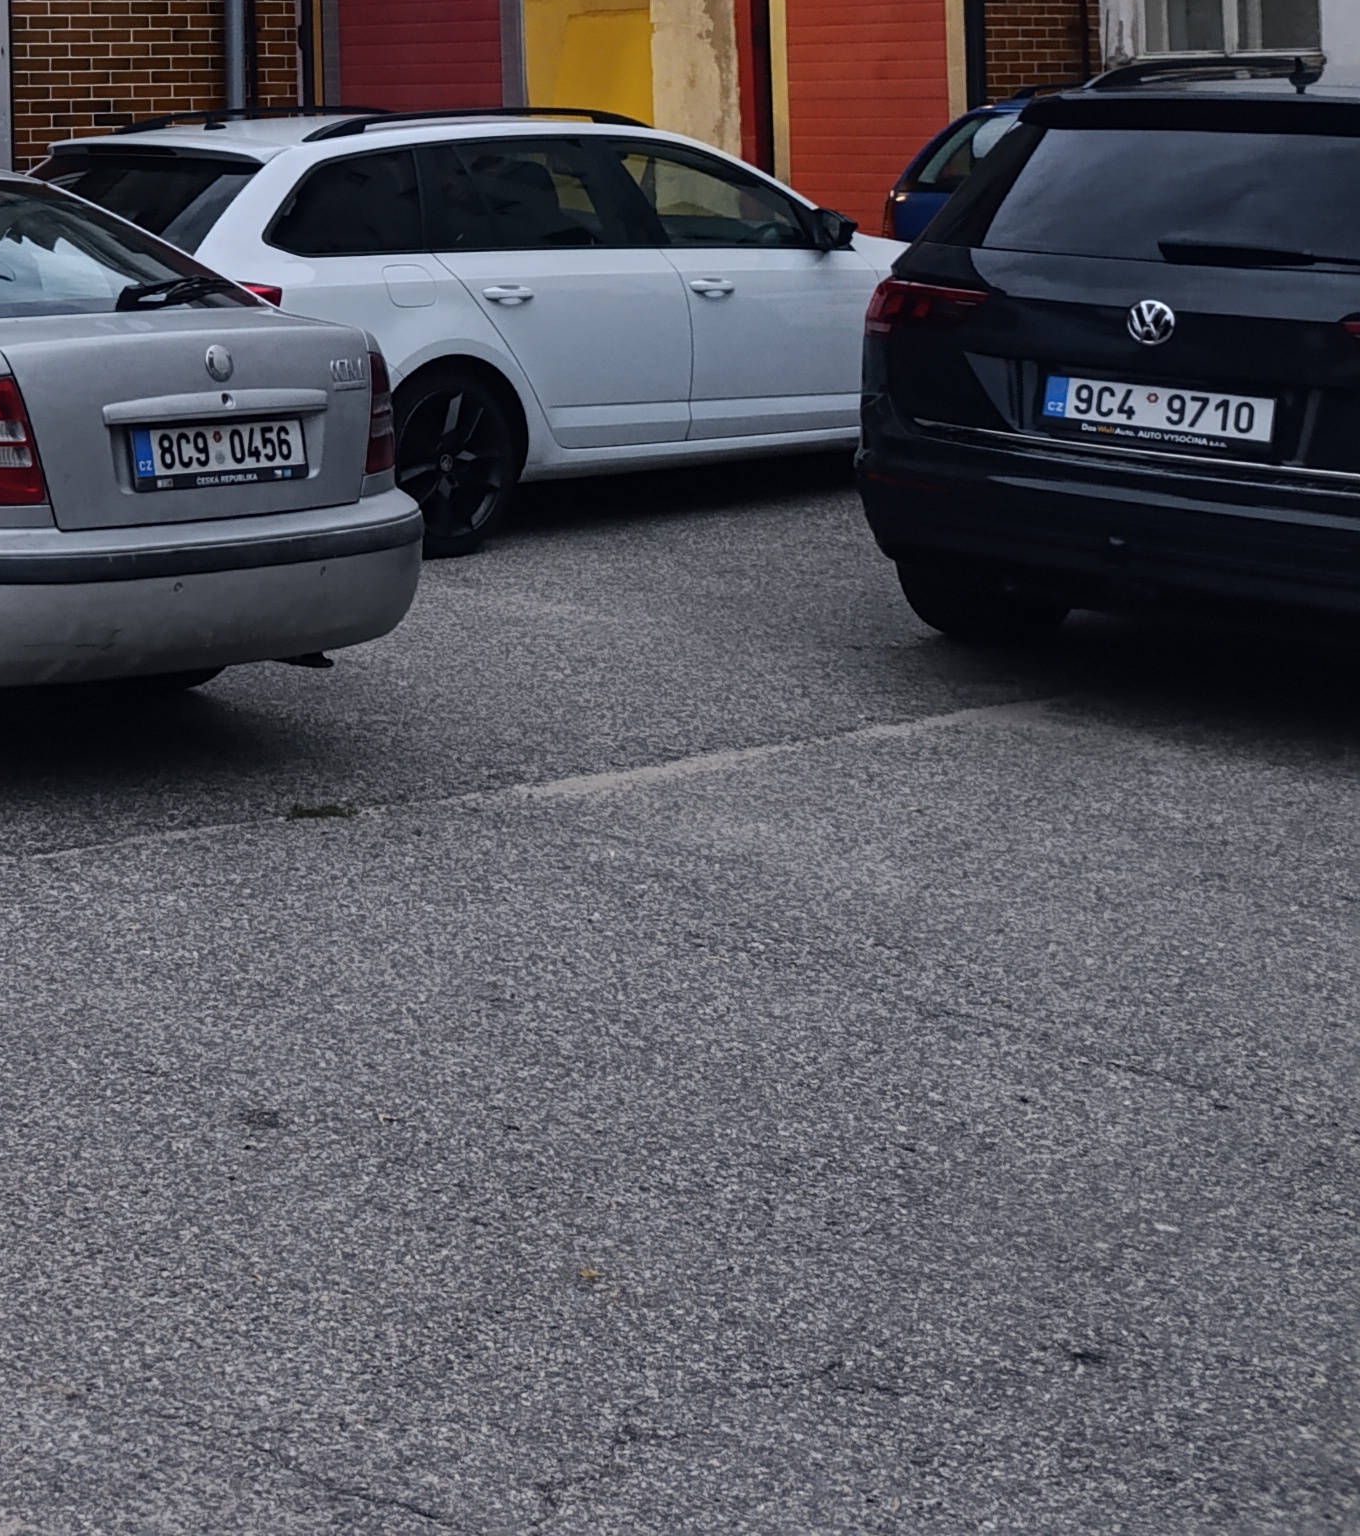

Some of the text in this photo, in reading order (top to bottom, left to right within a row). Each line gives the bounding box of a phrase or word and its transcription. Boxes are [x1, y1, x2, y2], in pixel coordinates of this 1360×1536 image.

[1047, 384, 1255, 434] CZ 9C4 9710
[139, 425, 292, 471] CZ 8C9 0456
[1137, 430, 1162, 440] AUTO
[1163, 432, 1208, 447] VYSOČINA
[196, 472, 258, 486] ČESKÁ REPUBLIKA
